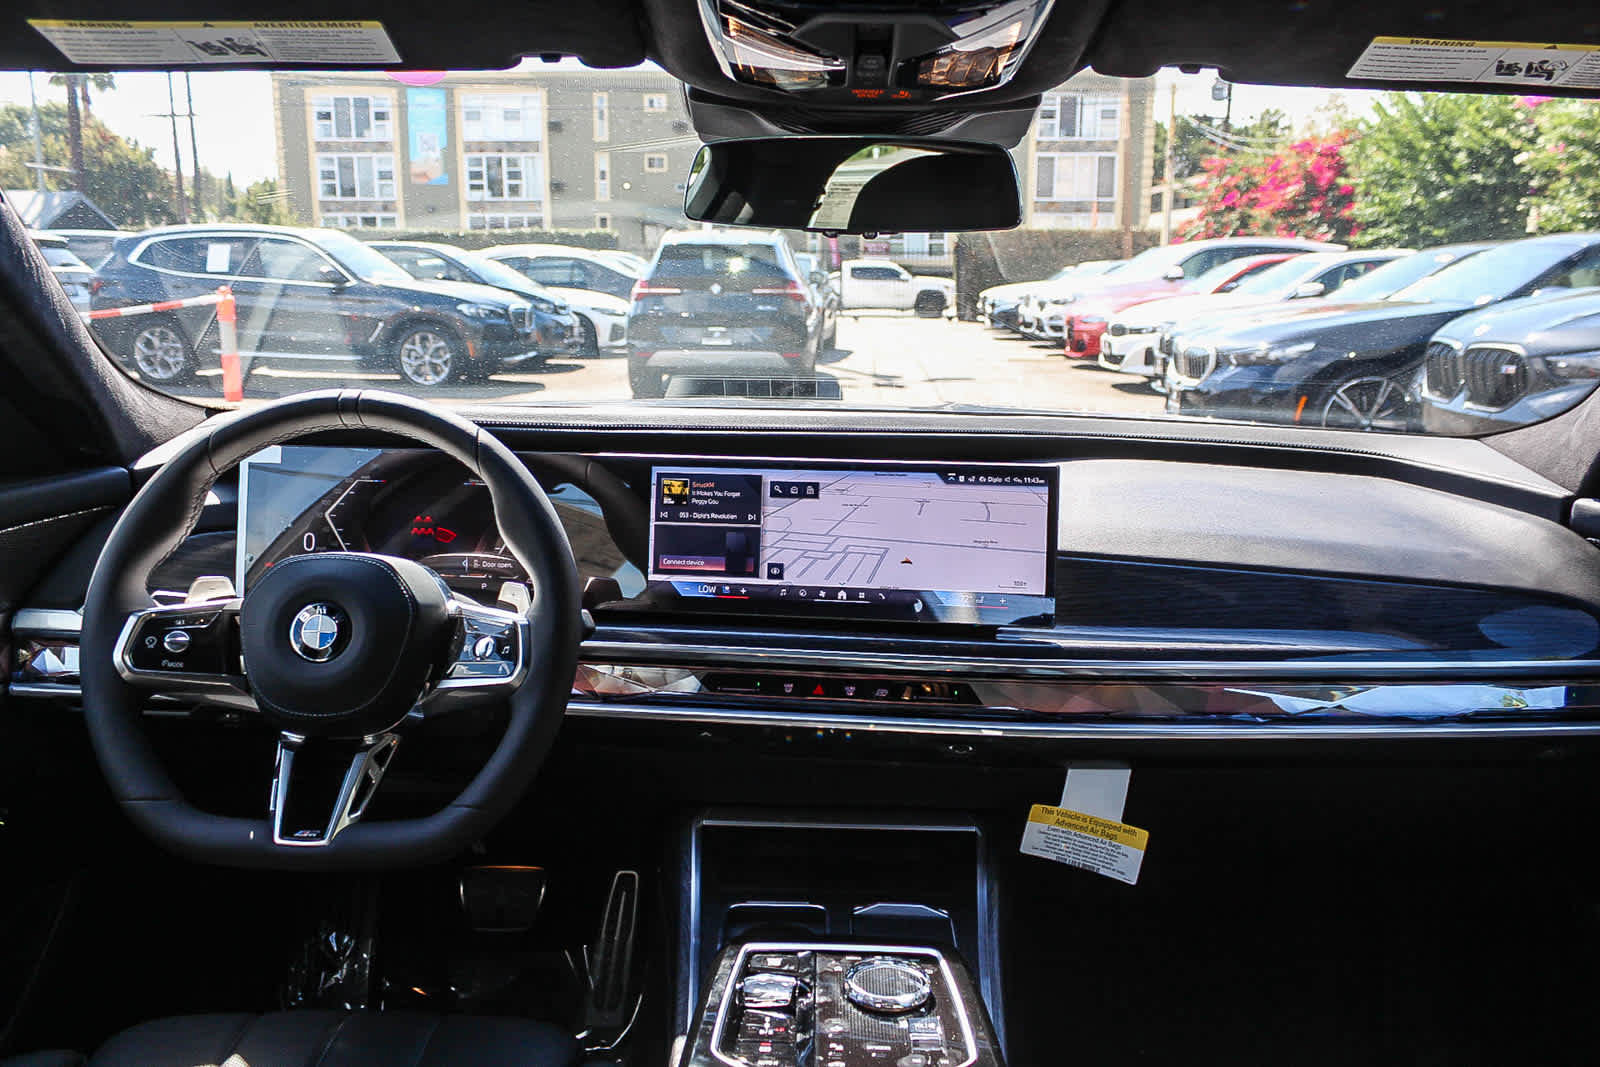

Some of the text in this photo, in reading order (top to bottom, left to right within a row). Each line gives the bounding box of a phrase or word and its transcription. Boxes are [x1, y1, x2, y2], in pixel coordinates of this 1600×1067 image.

[1409, 39, 1476, 47] WARNING
[303, 532, 316, 551] 0
[663, 558, 685, 566] Connect
[698, 585, 717, 593] LOW
[1041, 807, 1137, 837] This Vehicle is Equipped with
[1055, 818, 1118, 841] Advanced Air Bags
[1047, 825, 1059, 834] Even
[1073, 831, 1100, 843] Advanced
